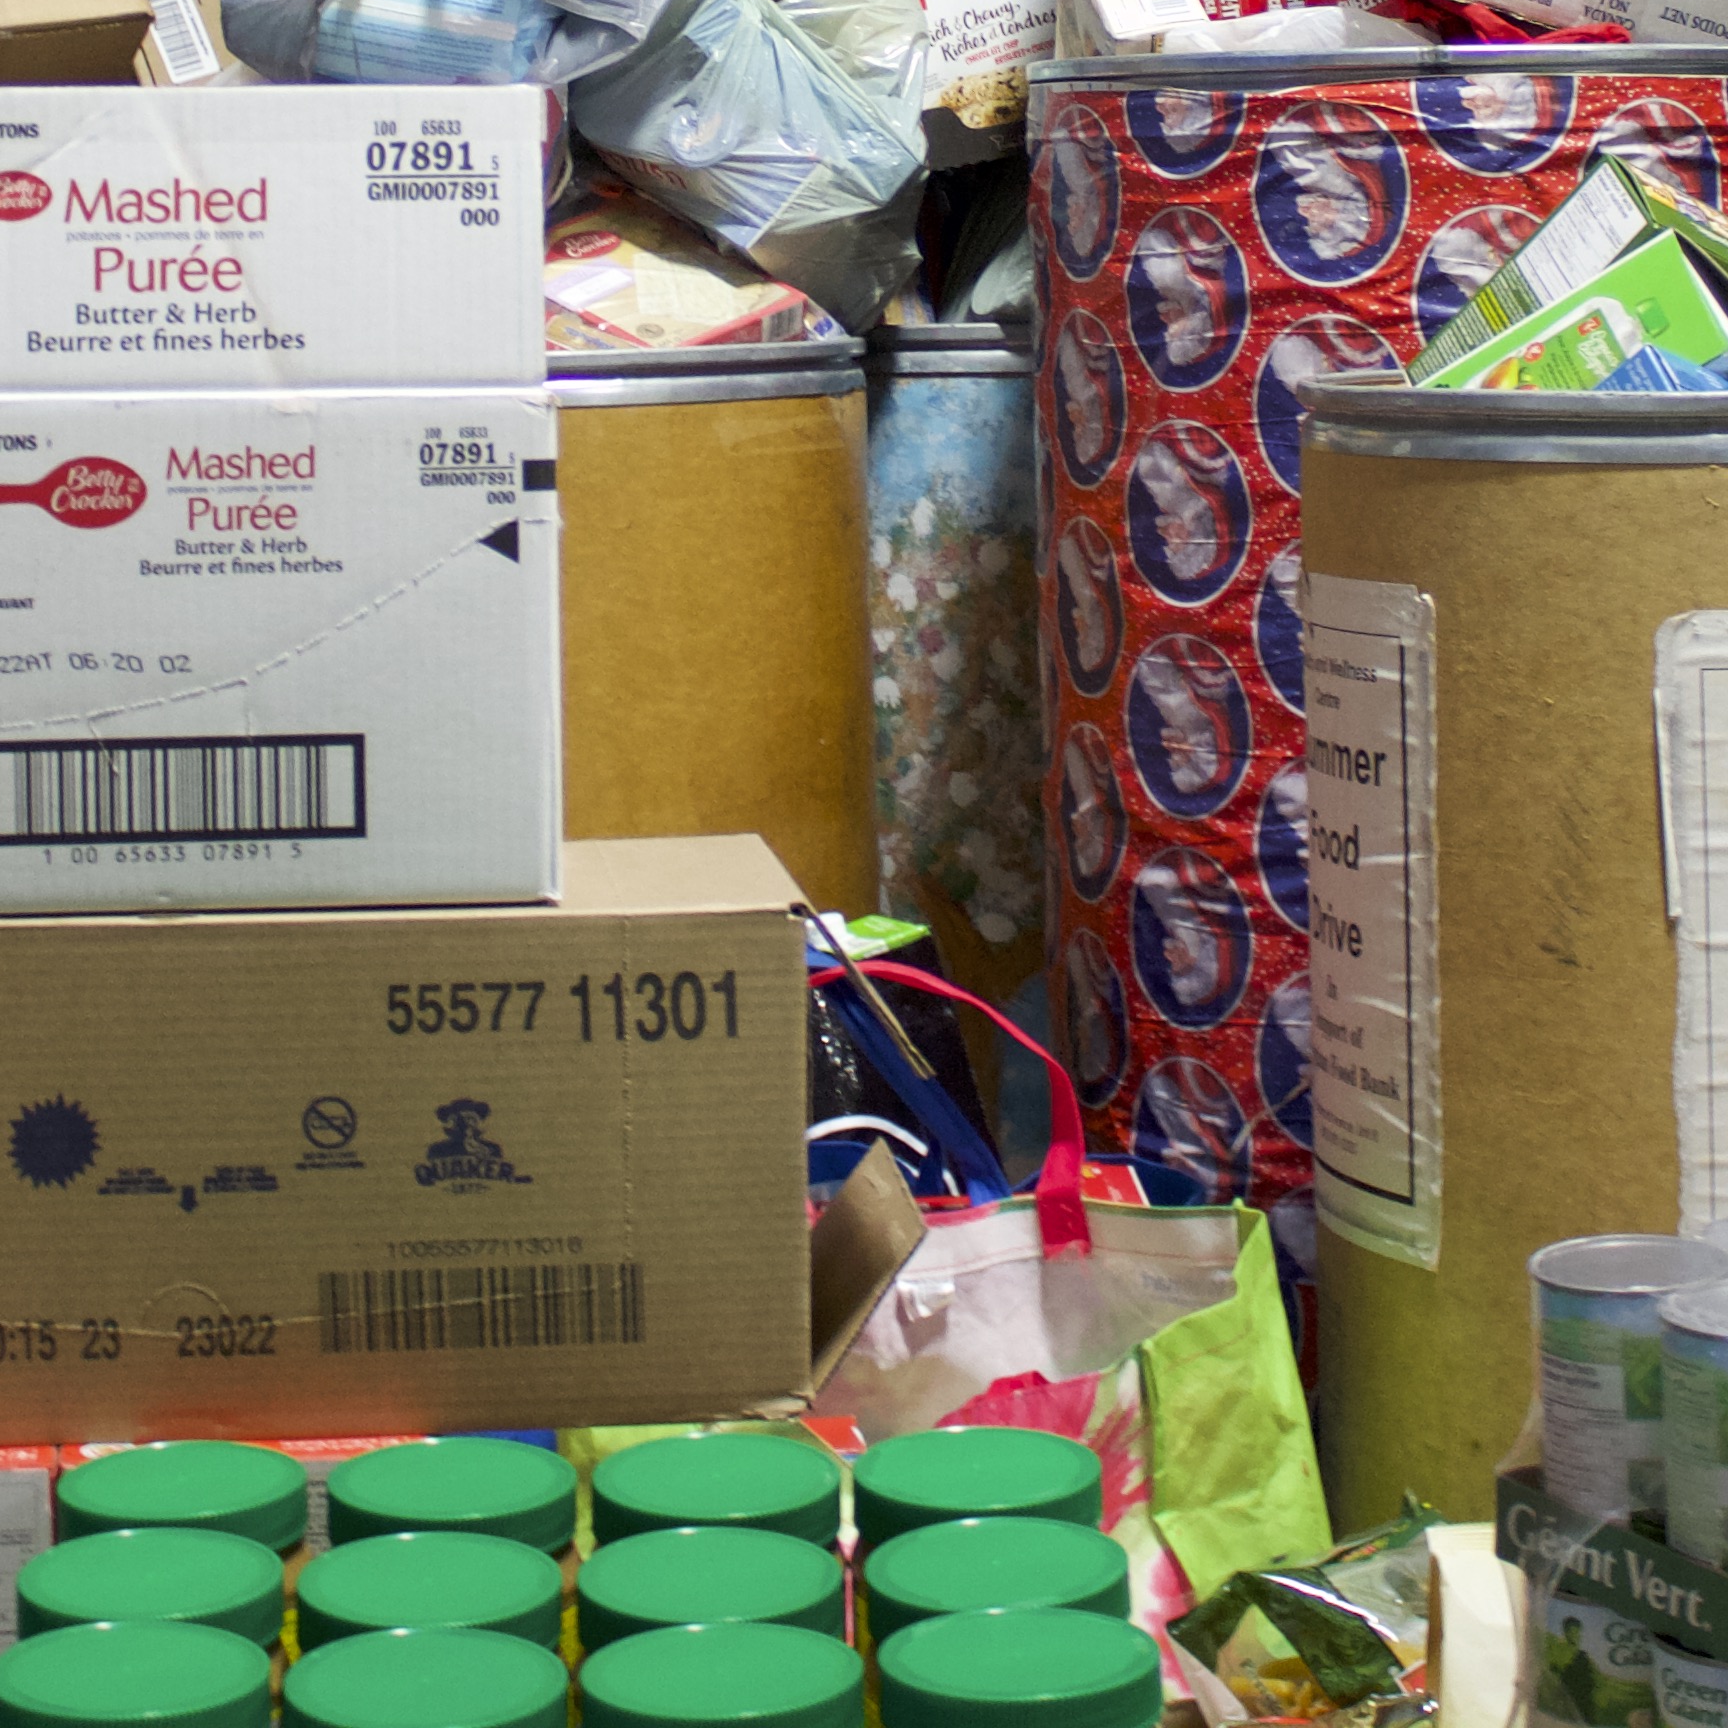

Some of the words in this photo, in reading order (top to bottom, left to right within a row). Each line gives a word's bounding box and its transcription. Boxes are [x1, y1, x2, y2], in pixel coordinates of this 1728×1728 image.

[365, 141, 475, 173] 07891
[64, 176, 269, 224] Mashed
[460, 208, 502, 227] 000
[93, 245, 245, 295] Purée
[75, 302, 160, 327] Butter
[166, 304, 187, 326] &
[193, 302, 258, 325] Herb
[26, 330, 114, 354] Beurre
[120, 331, 146, 354] et
[152, 329, 213, 353] fines
[219, 329, 306, 352] herbes
[165, 445, 317, 481] Mashed
[419, 441, 498, 467] 07891
[67, 465, 125, 495] Betty
[50, 486, 137, 514] Crocker
[187, 494, 299, 533] Purée
[174, 537, 237, 557] Butter
[241, 538, 257, 556] &
[261, 537, 309, 556] Herb
[139, 558, 204, 577] Beurre
[207, 559, 227, 577] et
[231, 557, 276, 576] fines
[280, 557, 345, 576] herbes
[386, 981, 546, 1036] 55577
[570, 970, 739, 1043] 11301
[80, 1318, 121, 1361] 23
[177, 1315, 276, 1358] 23022
